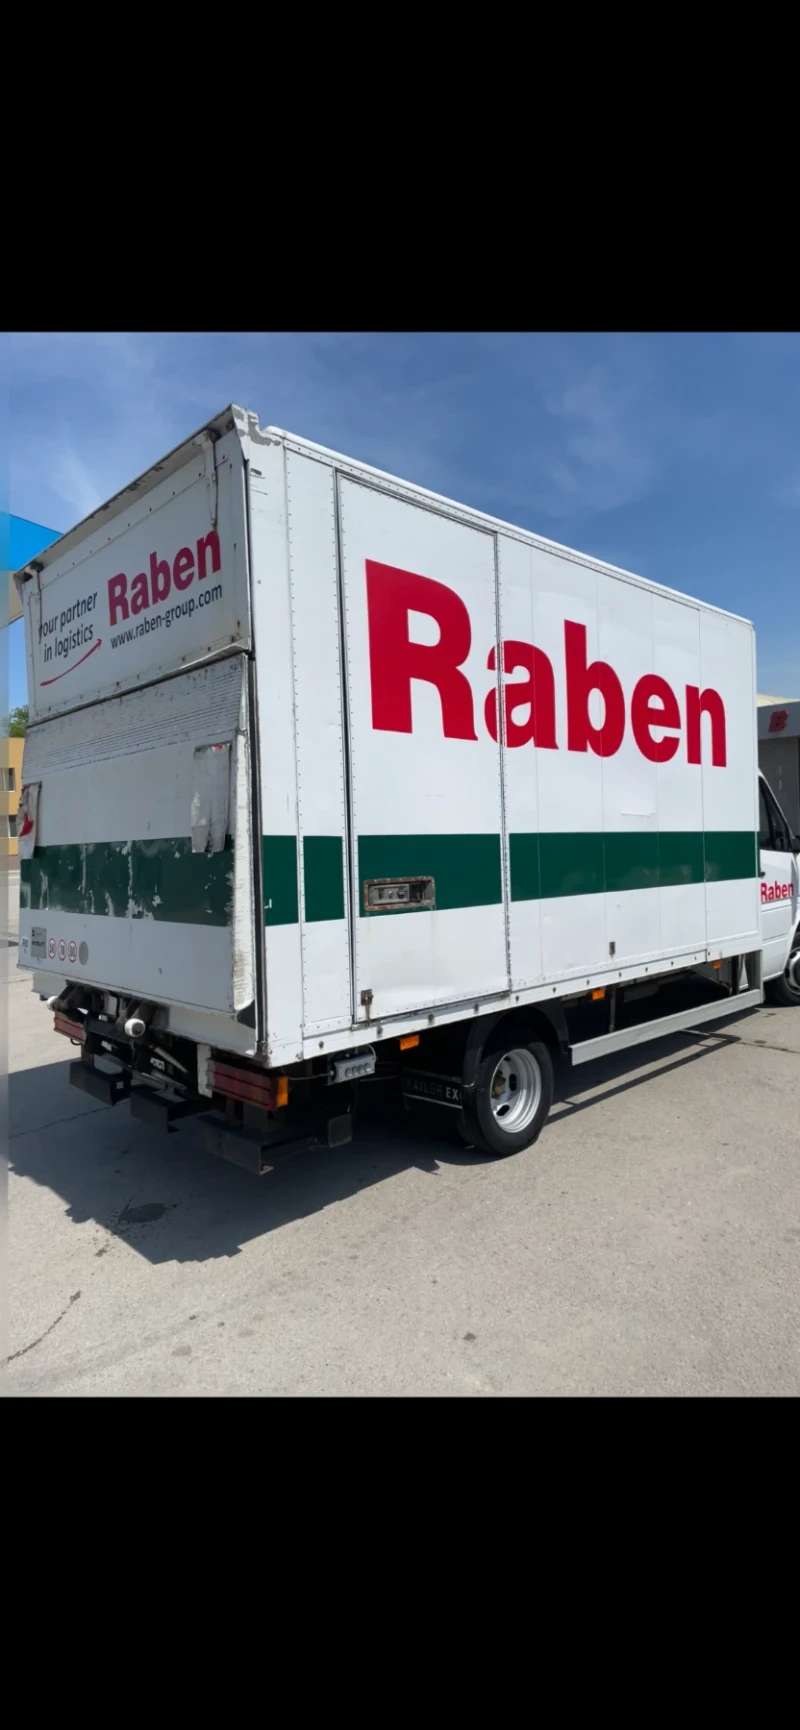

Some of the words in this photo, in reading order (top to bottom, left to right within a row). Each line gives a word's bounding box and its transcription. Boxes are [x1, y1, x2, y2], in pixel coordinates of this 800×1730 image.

[107, 530, 222, 627] Raben
[60, 591, 98, 631] partner
[110, 584, 223, 649] www.raben-group.com
[43, 643, 53, 662] in
[54, 624, 93, 658] logistics
[365, 559, 727, 768] Raben
[760, 880, 794, 902] Raben
